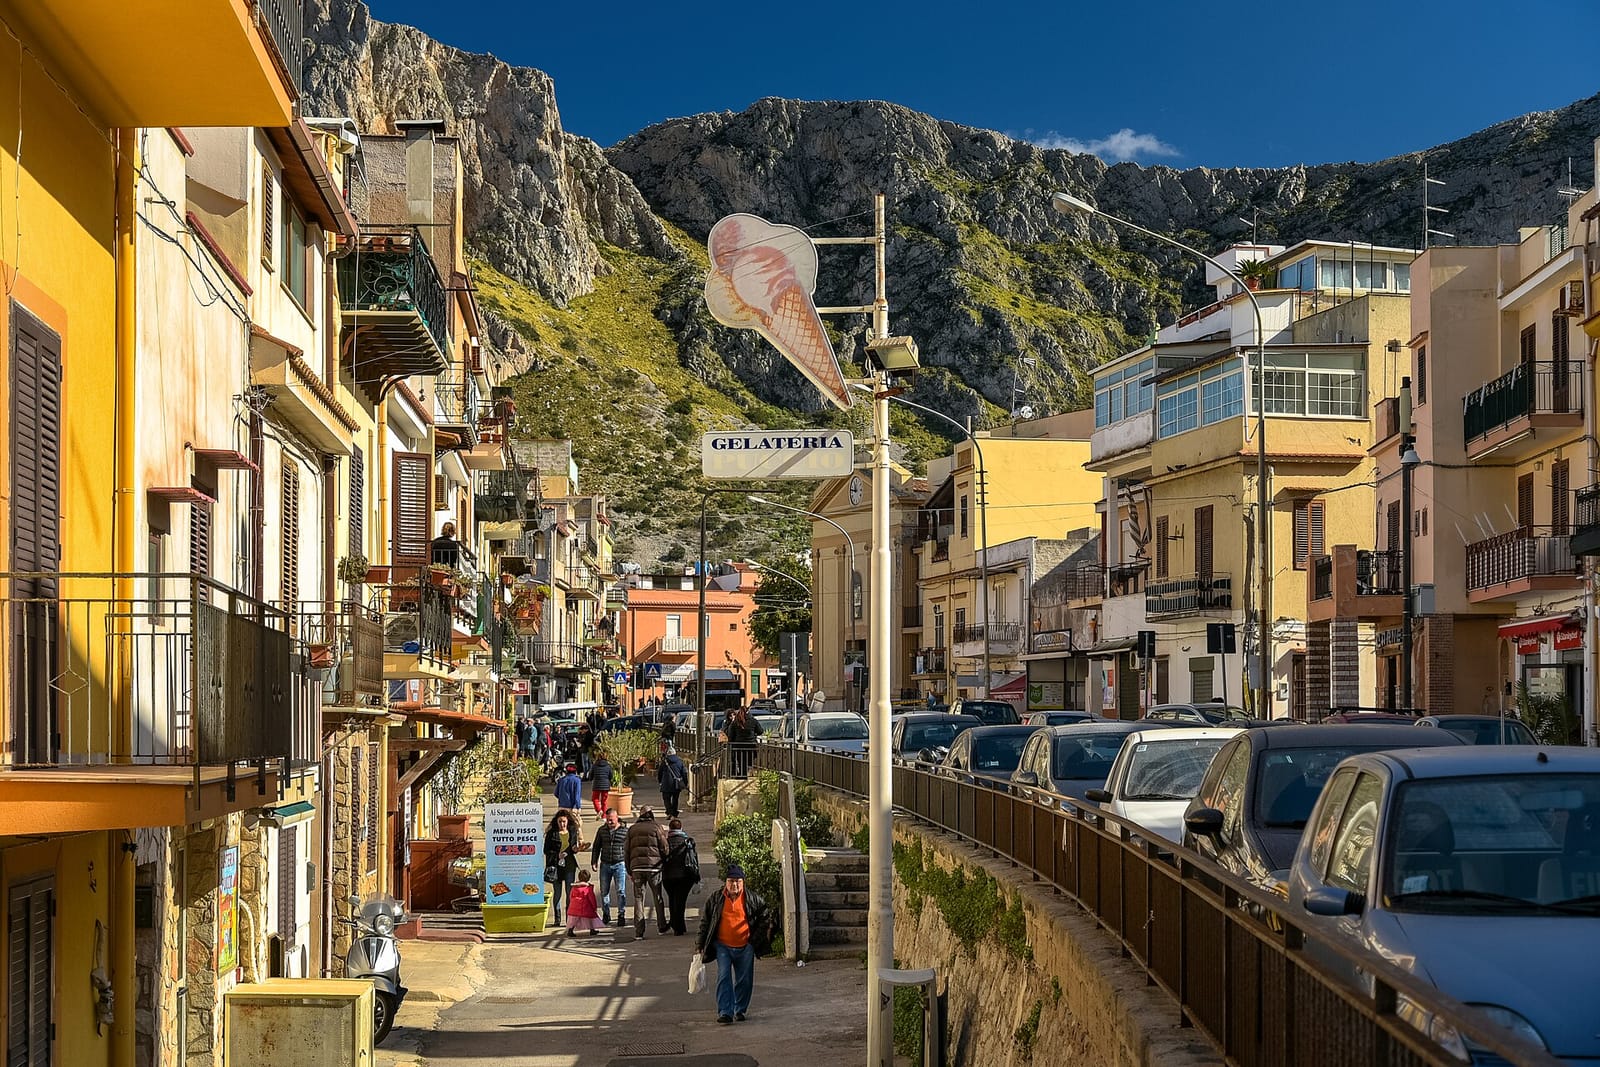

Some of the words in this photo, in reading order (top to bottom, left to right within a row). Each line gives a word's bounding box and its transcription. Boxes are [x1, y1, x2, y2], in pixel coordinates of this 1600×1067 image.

[712, 437, 843, 450] GELATERIA
[496, 808, 515, 817] Sapori
[515, 808, 524, 816] del
[524, 808, 540, 816] Golfo
